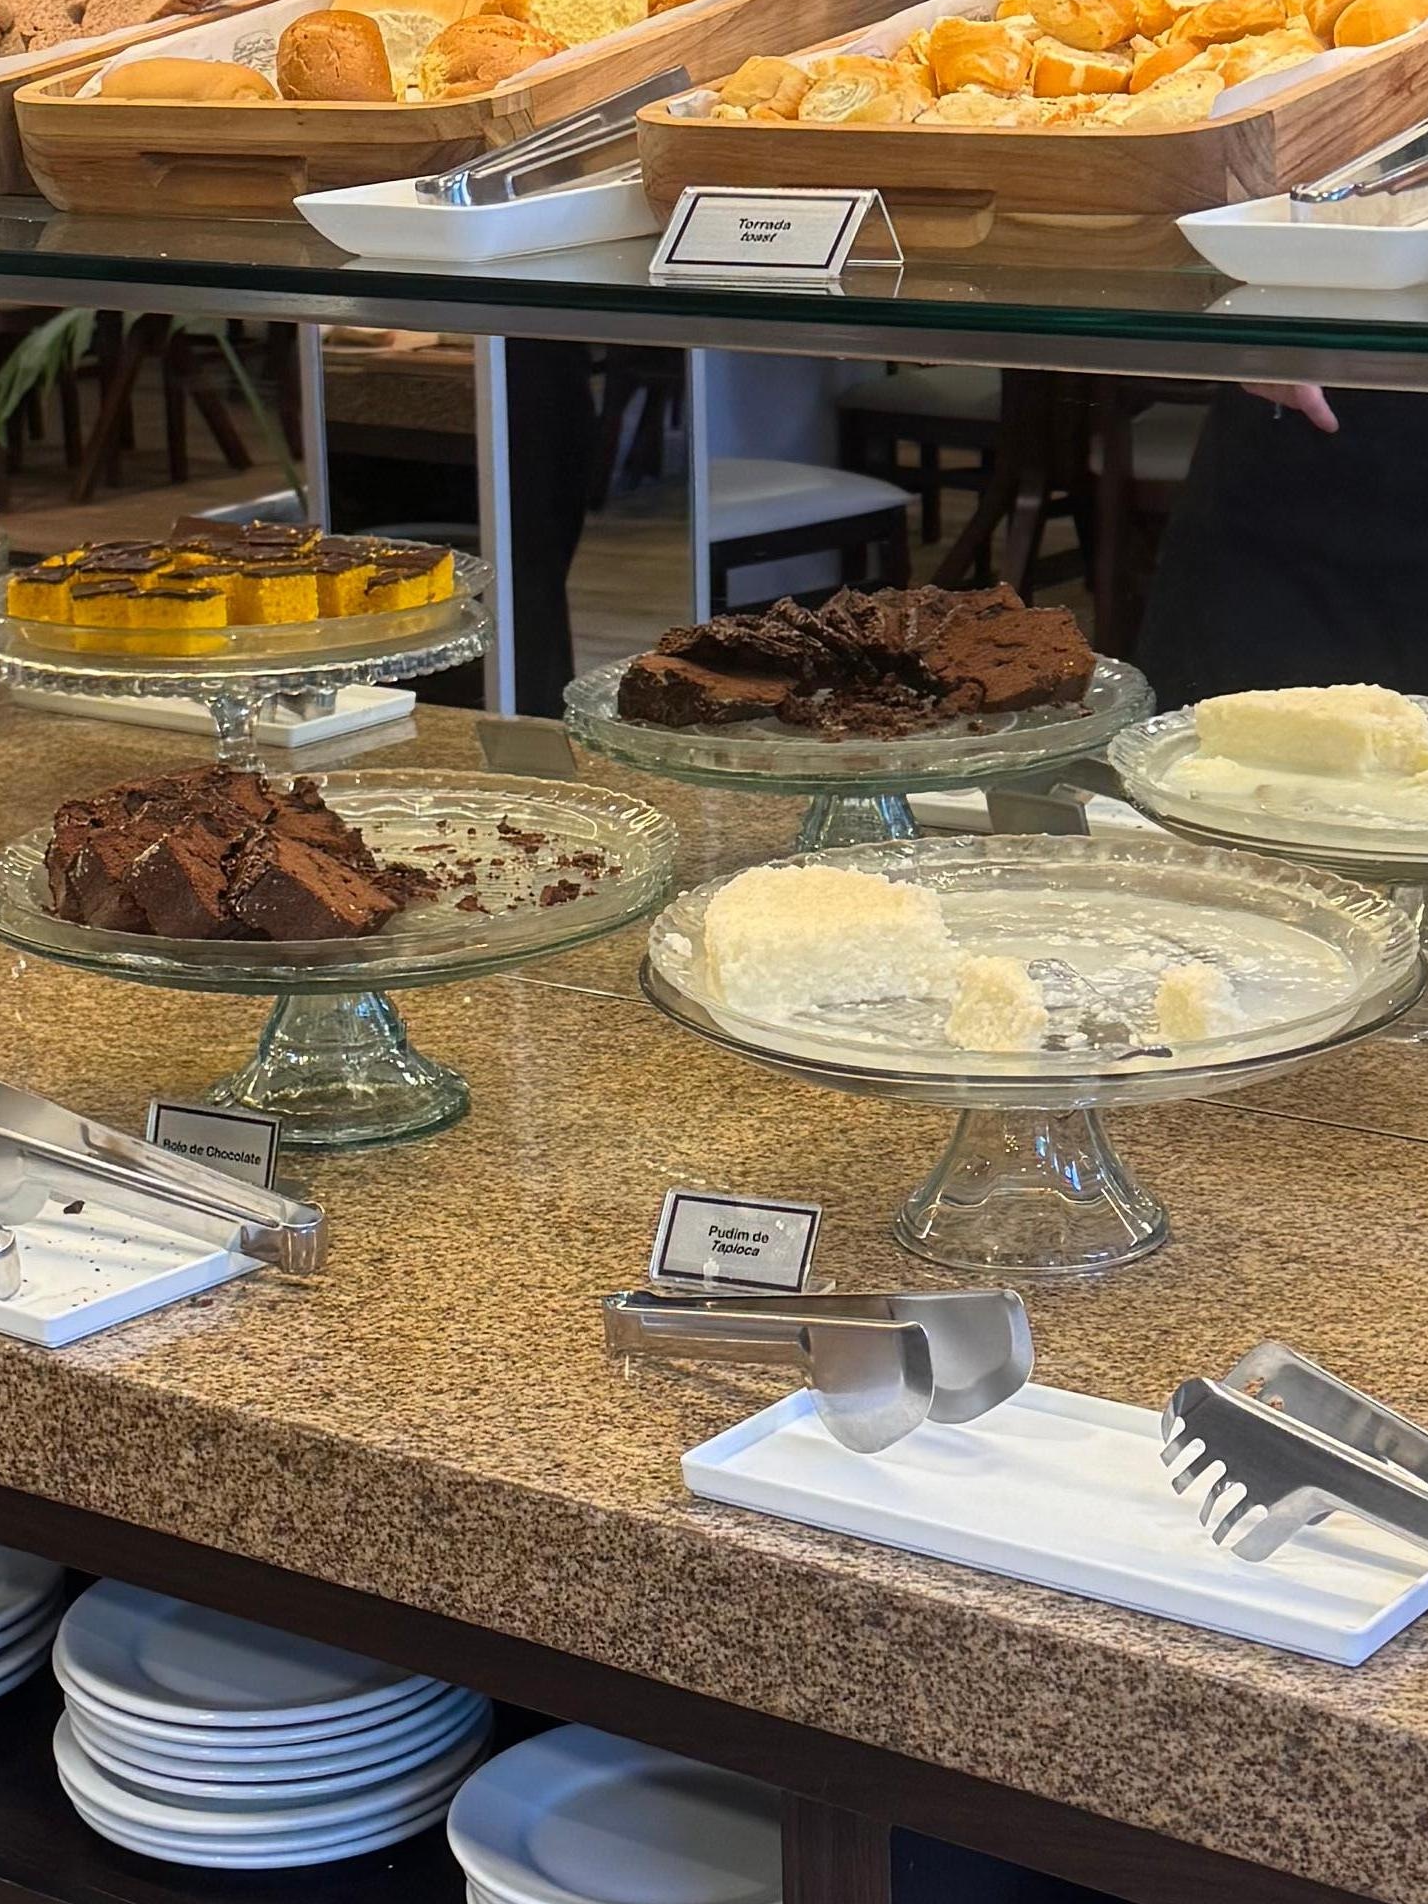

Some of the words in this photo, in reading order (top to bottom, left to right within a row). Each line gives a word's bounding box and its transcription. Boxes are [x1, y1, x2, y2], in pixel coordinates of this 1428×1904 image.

[738, 217, 791, 231] Torrada
[189, 1144, 205, 1156] de
[206, 1146, 262, 1166] Chocolate
[708, 1225, 749, 1241] Pudim
[752, 1231, 769, 1244] de
[711, 1240, 760, 1257] Tapioca
